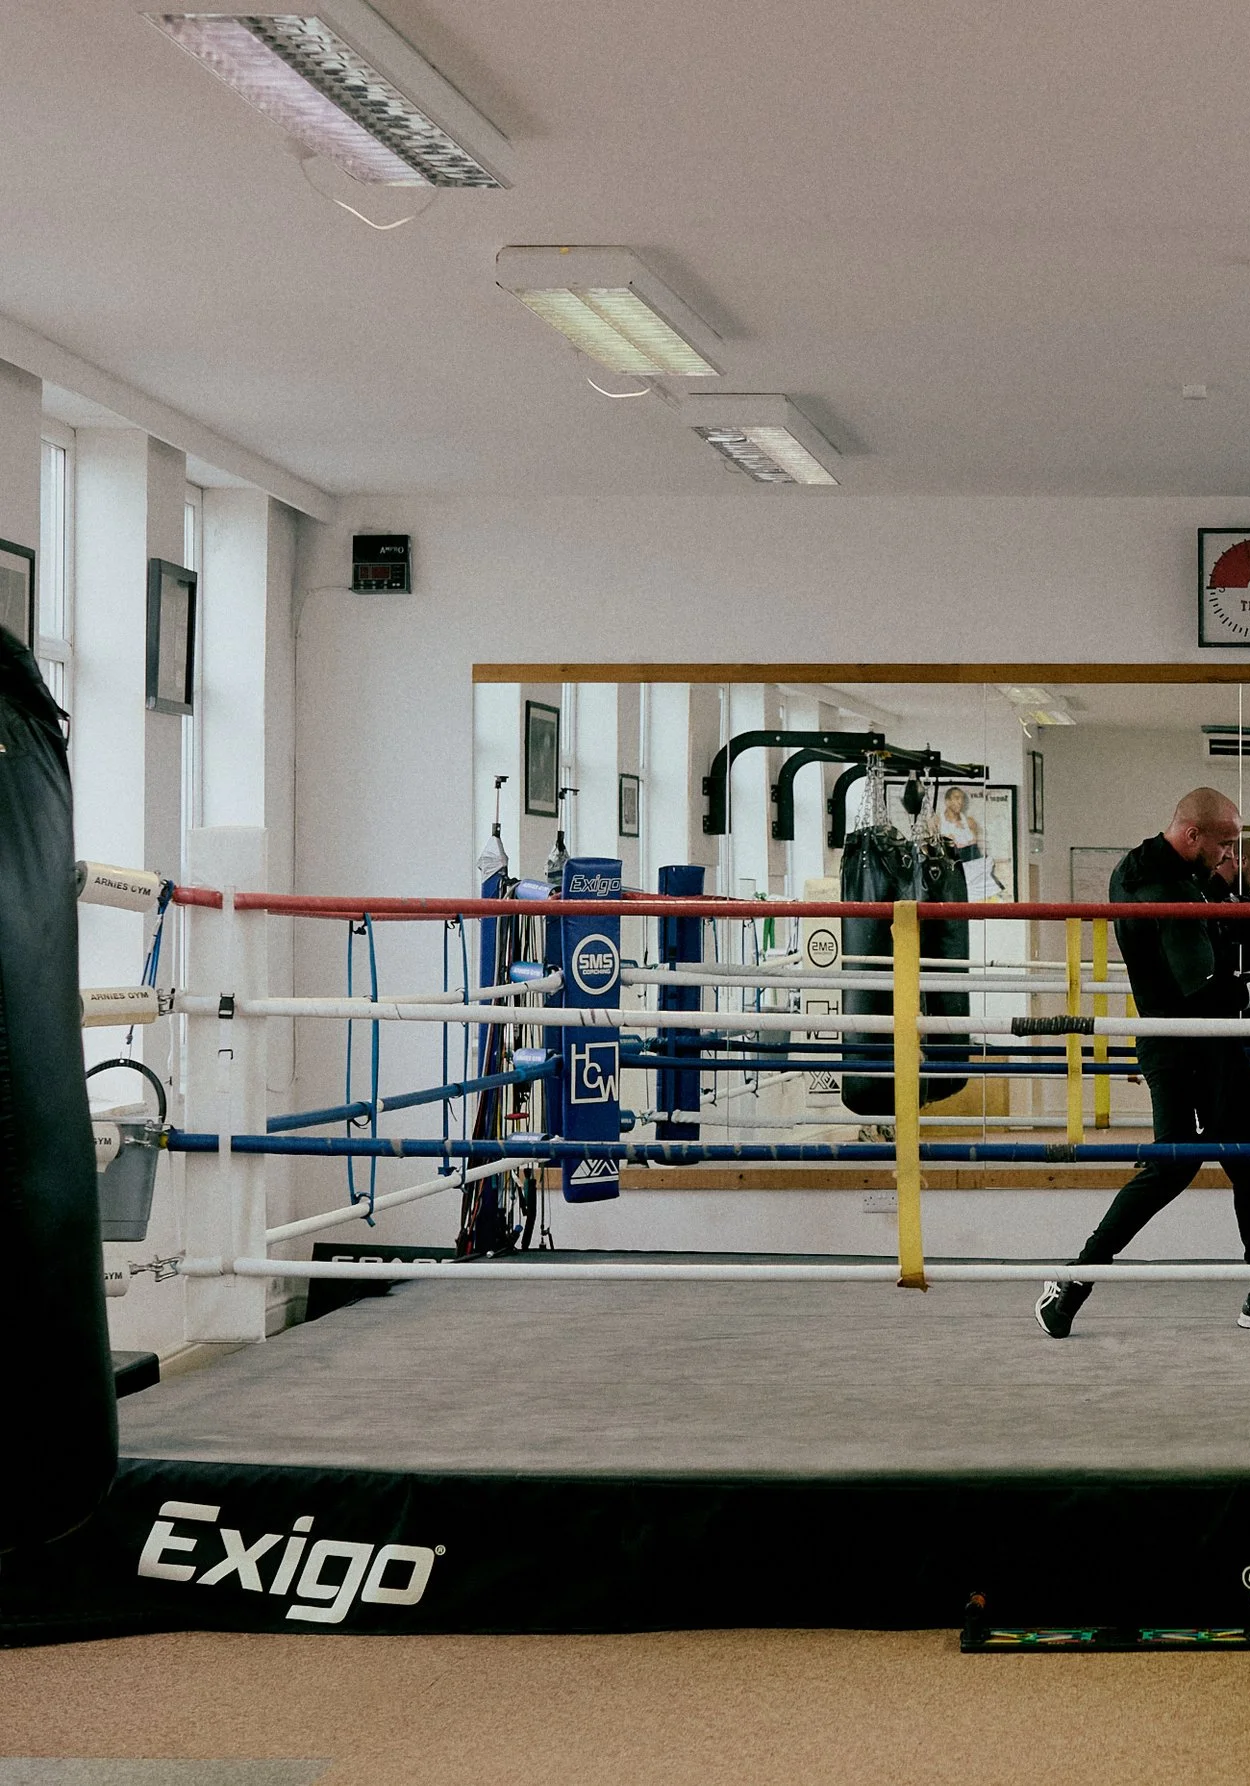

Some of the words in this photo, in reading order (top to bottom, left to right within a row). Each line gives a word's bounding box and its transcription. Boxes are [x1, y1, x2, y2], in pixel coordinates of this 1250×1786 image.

[94, 876, 128, 891] ARNIES
[131, 885, 152, 897] GYM
[569, 874, 621, 896] Exigo
[579, 953, 613, 969] SMS
[90, 992, 126, 1001] ARNIES
[128, 991, 149, 1000] GYM
